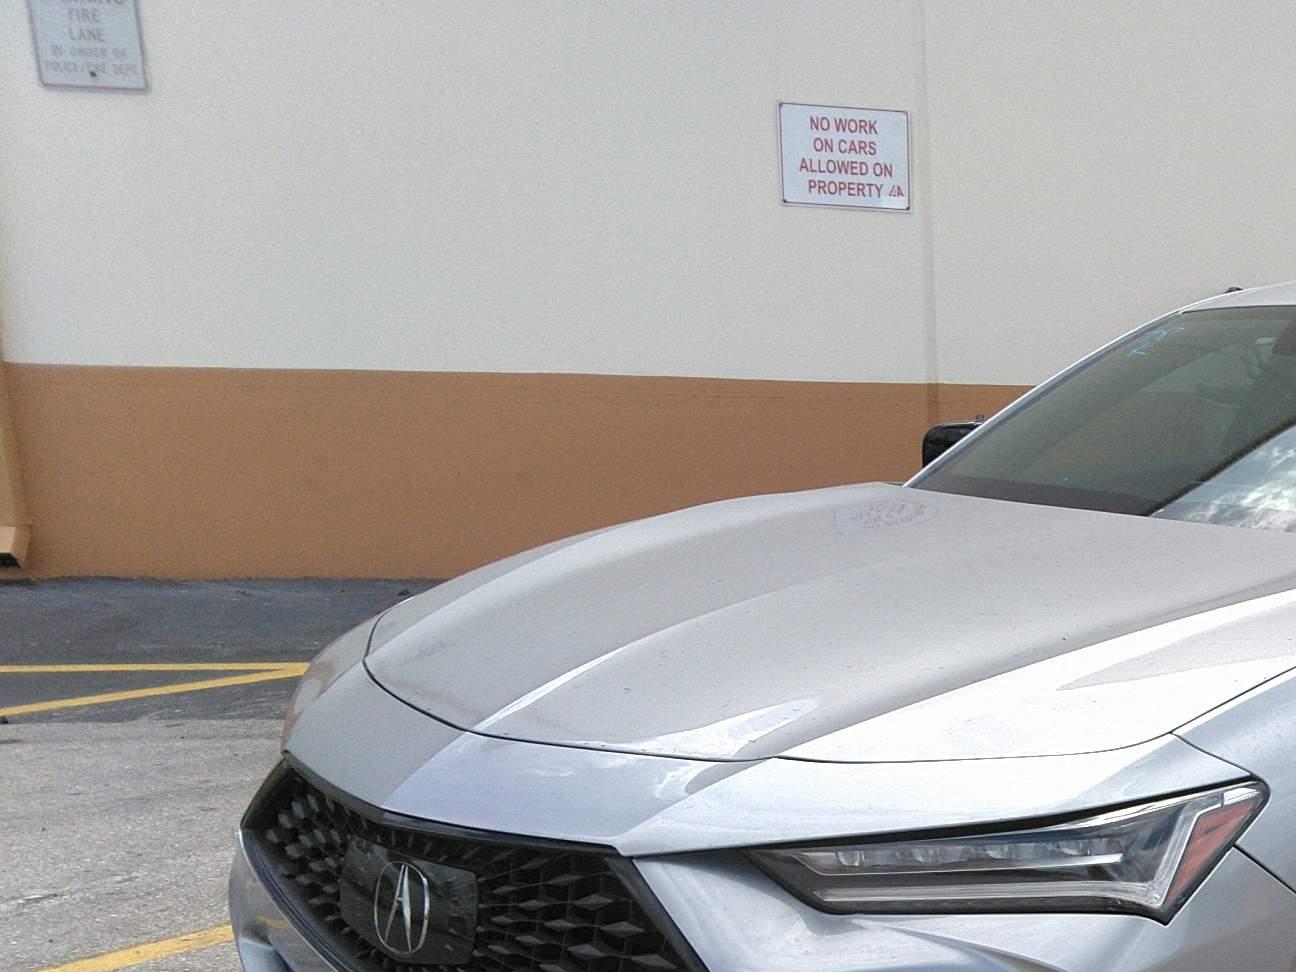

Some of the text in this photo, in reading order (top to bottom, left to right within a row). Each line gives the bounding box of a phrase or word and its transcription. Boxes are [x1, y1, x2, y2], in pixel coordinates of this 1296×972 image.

[68, 8, 101, 22] FIRE
[68, 28, 106, 43] LANE
[809, 115, 878, 135] NO WORK
[813, 137, 877, 156] ON CARS
[799, 157, 893, 177] ALLOWED ON
[808, 179, 883, 198] PROPERTY
